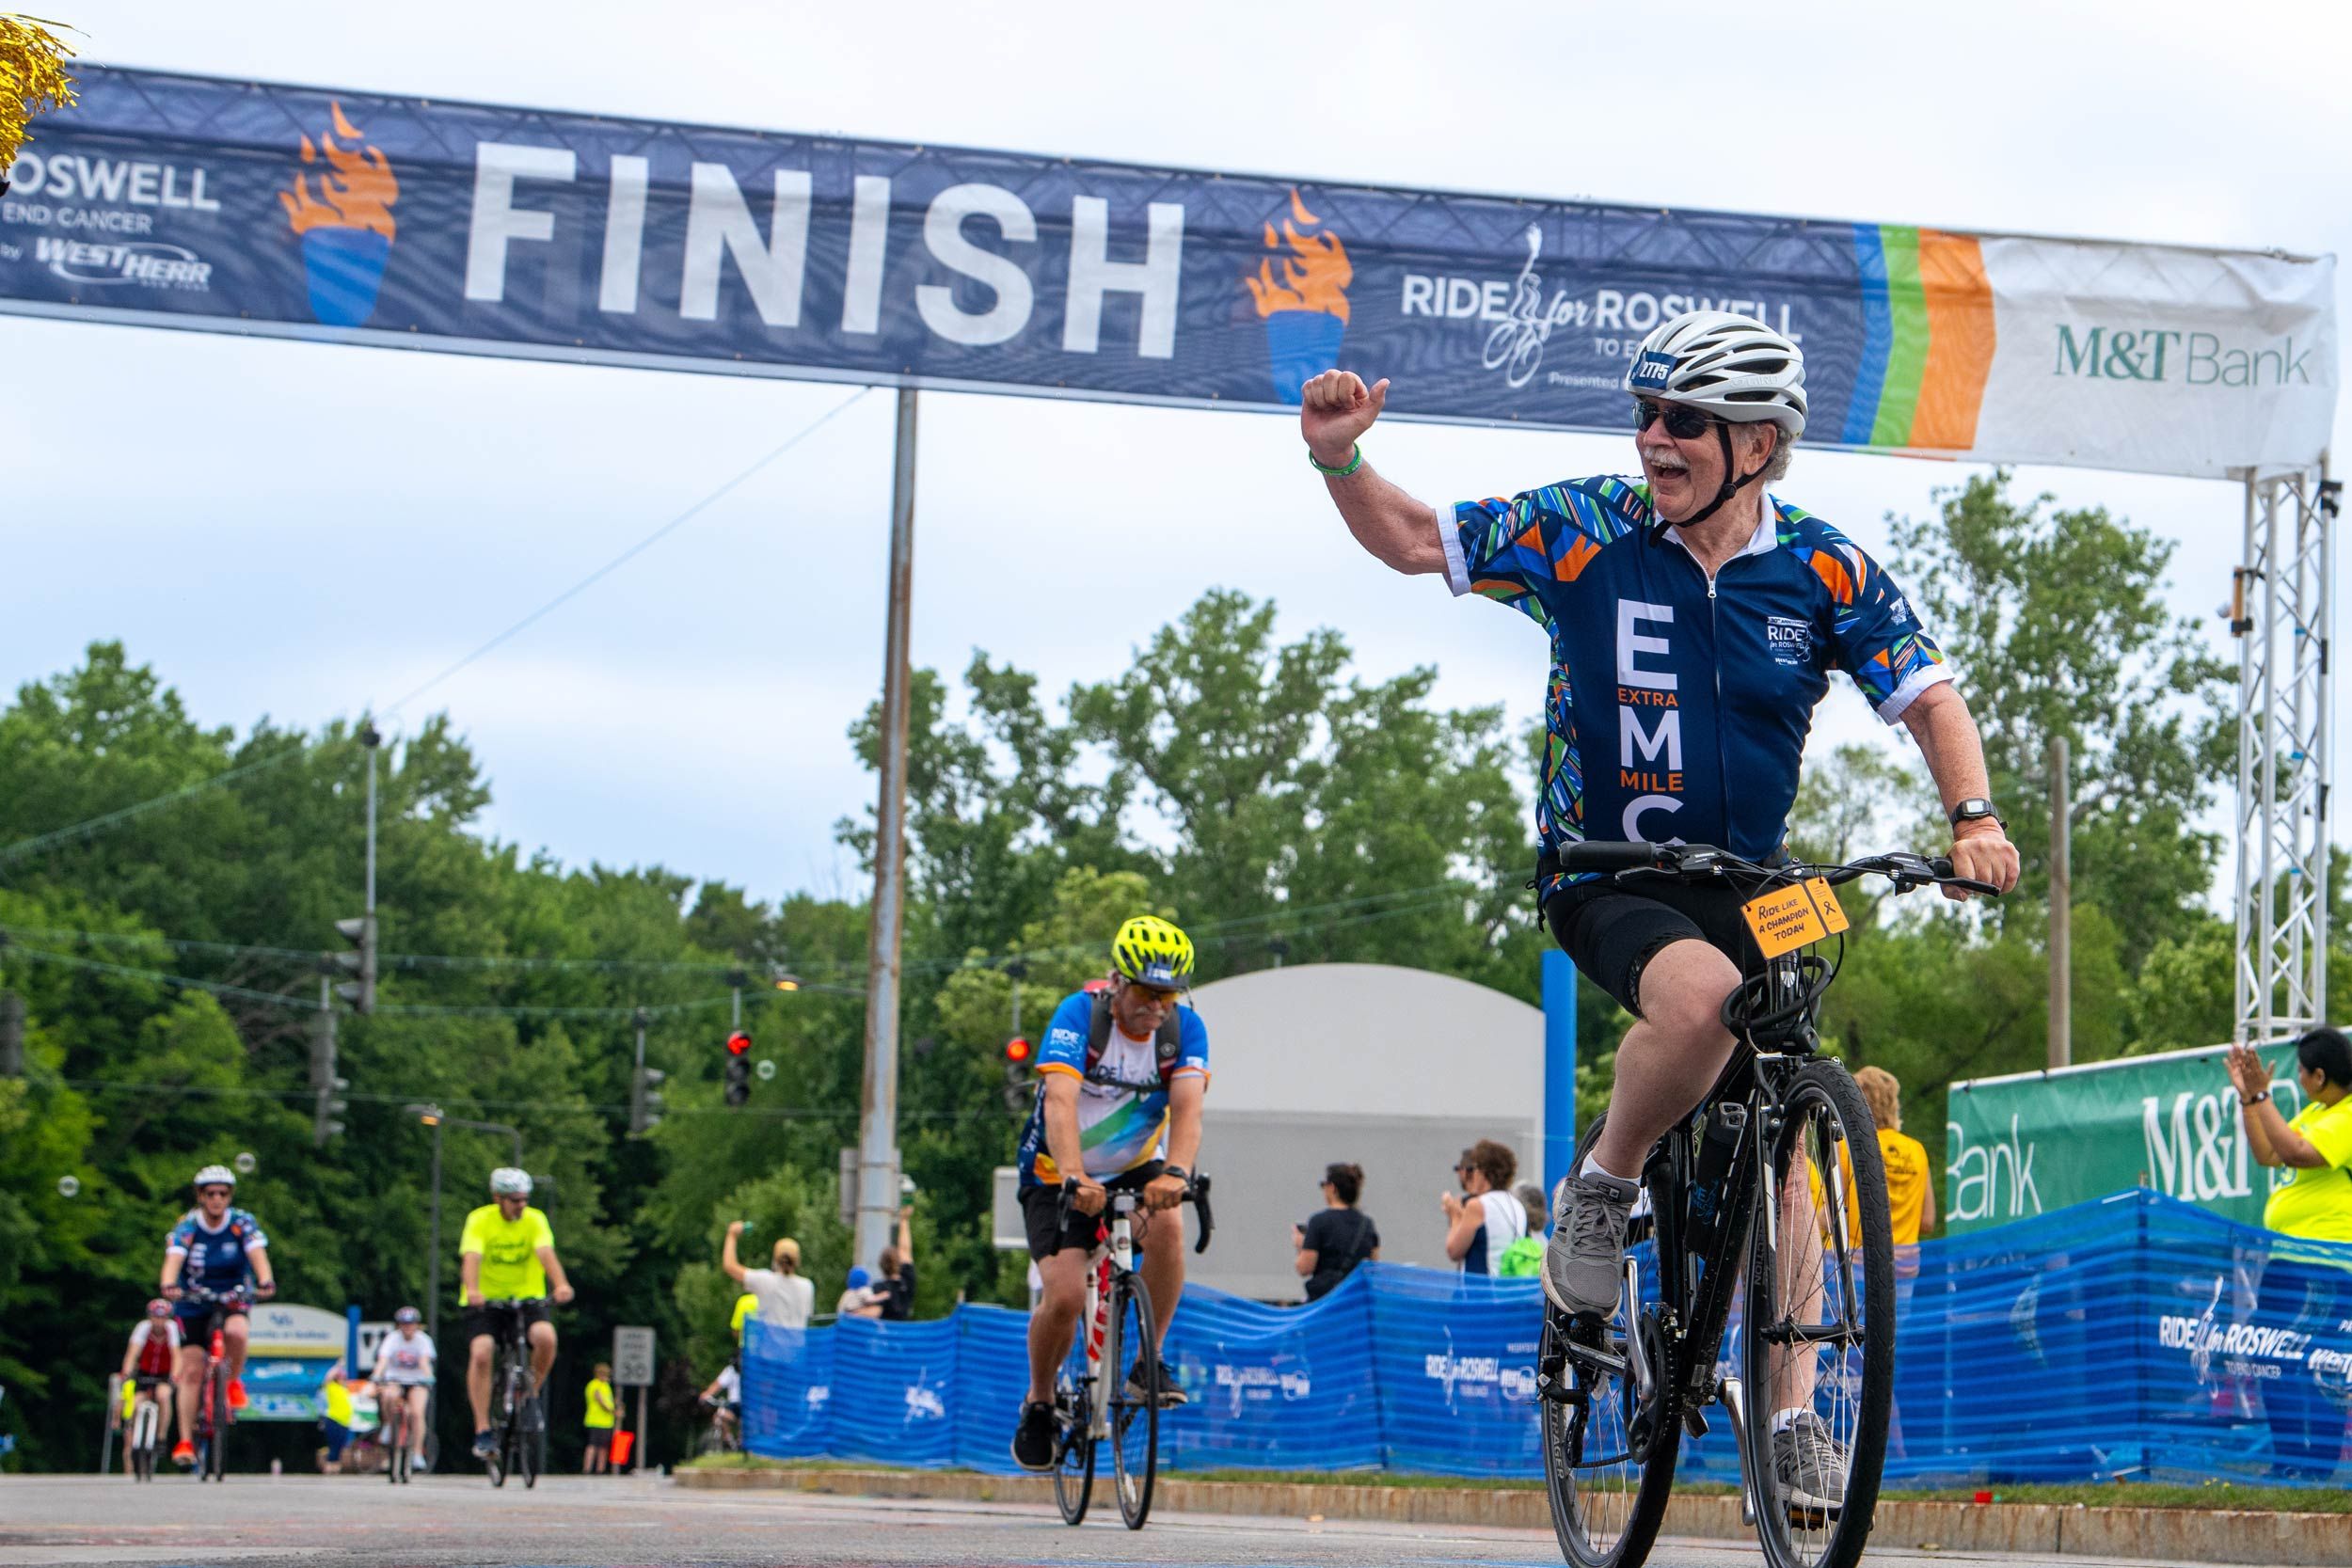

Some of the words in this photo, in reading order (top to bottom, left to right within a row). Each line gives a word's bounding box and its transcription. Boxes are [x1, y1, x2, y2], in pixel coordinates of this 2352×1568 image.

[8, 151, 221, 212] OSWELL
[3, 201, 51, 227] END
[56, 206, 153, 234] CANCER
[465, 141, 1184, 359] FINISH
[1402, 274, 1511, 322] RIDE
[1540, 289, 1596, 341] for
[1594, 336, 1621, 357] TO
[2053, 323, 2182, 382] M&T
[2185, 331, 2312, 388] Bank
[1548, 370, 1623, 391] Presented
[1640, 360, 1671, 380] 2775
[1617, 597, 1677, 691] E
[1767, 625, 1805, 641] RIDE
[1617, 687, 1678, 707] EXTRA
[1619, 705, 1683, 770] M
[1620, 768, 1684, 792] MILE
[1758, 905, 1780, 920] RIDE
[1781, 898, 1799, 911] LIKE
[1758, 926, 1766, 934] A
[1767, 908, 1809, 931] CHAMPION
[1773, 922, 1805, 942] TODAY
[2142, 1085, 2252, 1202] M&T
[2159, 1315, 2200, 1351] RIDE
[2223, 1323, 2312, 1360] ROSWELL
[1551, 1399, 1565, 1480] NTRAGER
